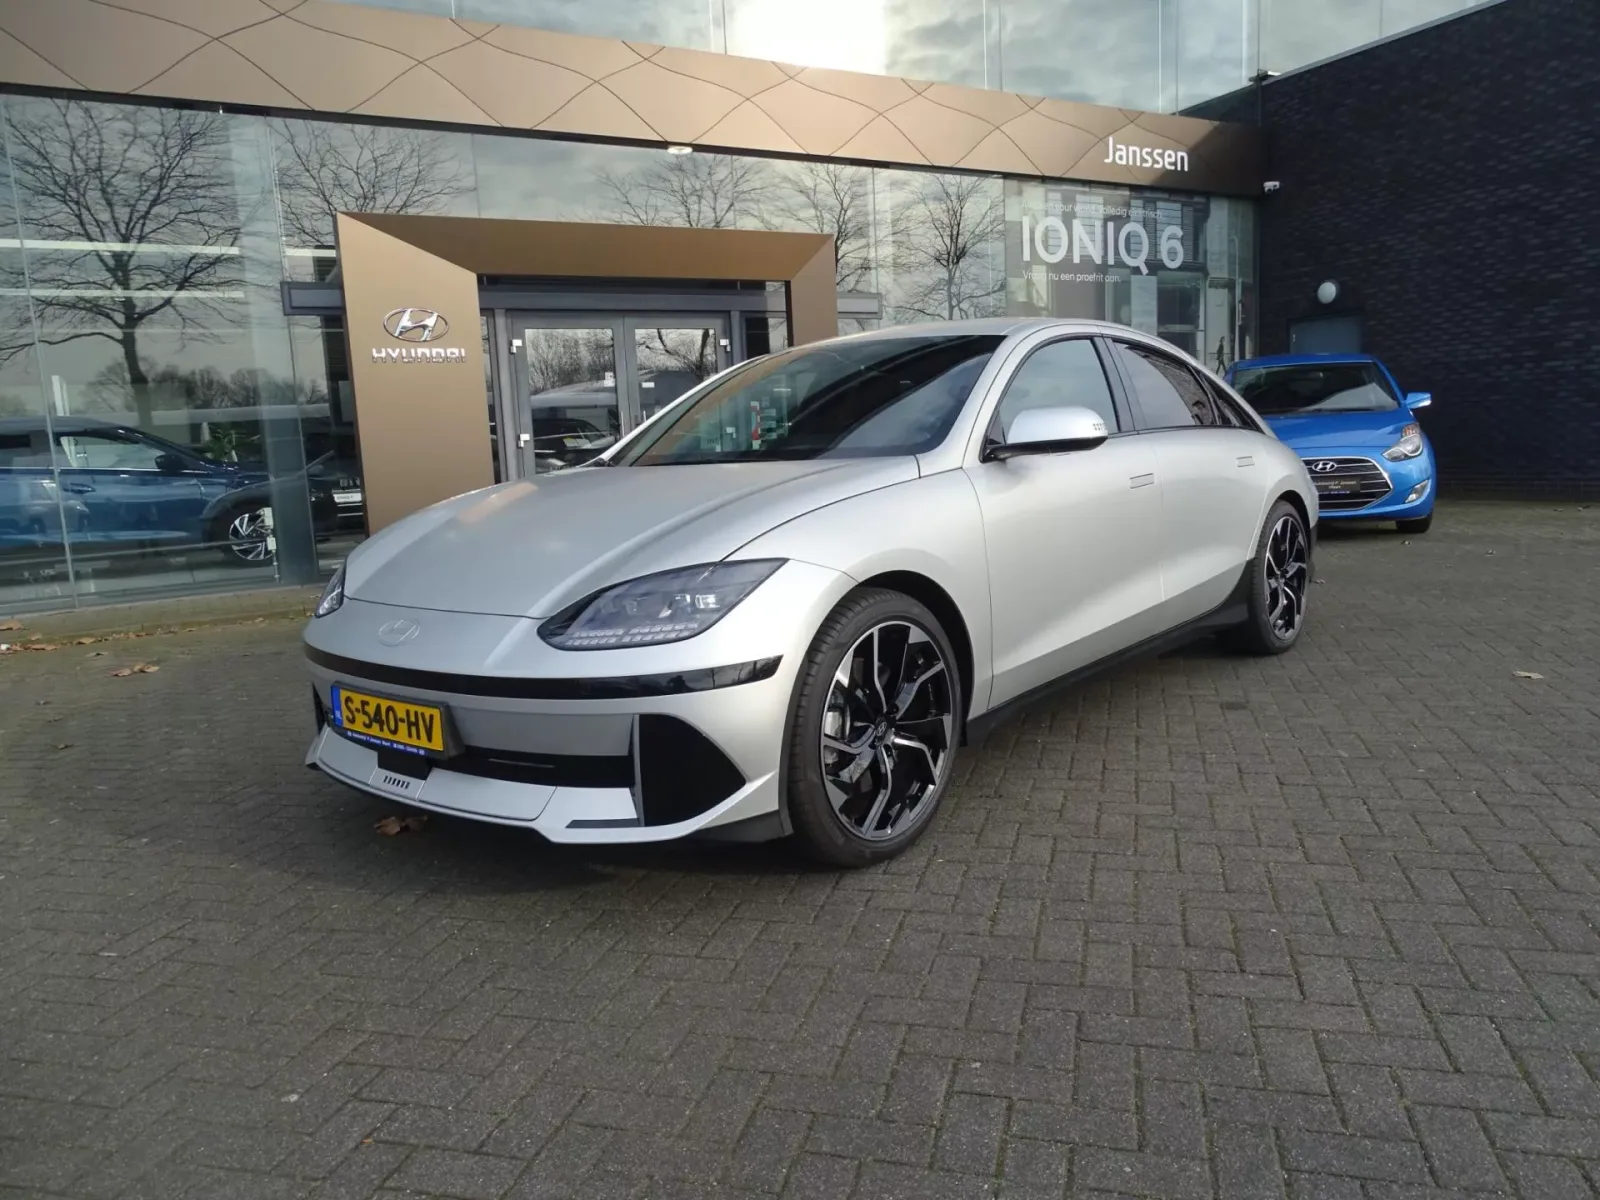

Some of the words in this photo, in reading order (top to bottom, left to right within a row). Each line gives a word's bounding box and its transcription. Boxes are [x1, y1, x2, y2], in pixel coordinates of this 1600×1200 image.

[1104, 136, 1189, 172] Janssen
[1097, 205, 1127, 218] olledig
[1022, 216, 1149, 276] IONIQ
[1160, 225, 1184, 269] 6
[1048, 272, 1059, 281] nu
[1060, 273, 1075, 281] een
[371, 347, 467, 363] HYUNDAI
[343, 695, 435, 744] S-540-HV
